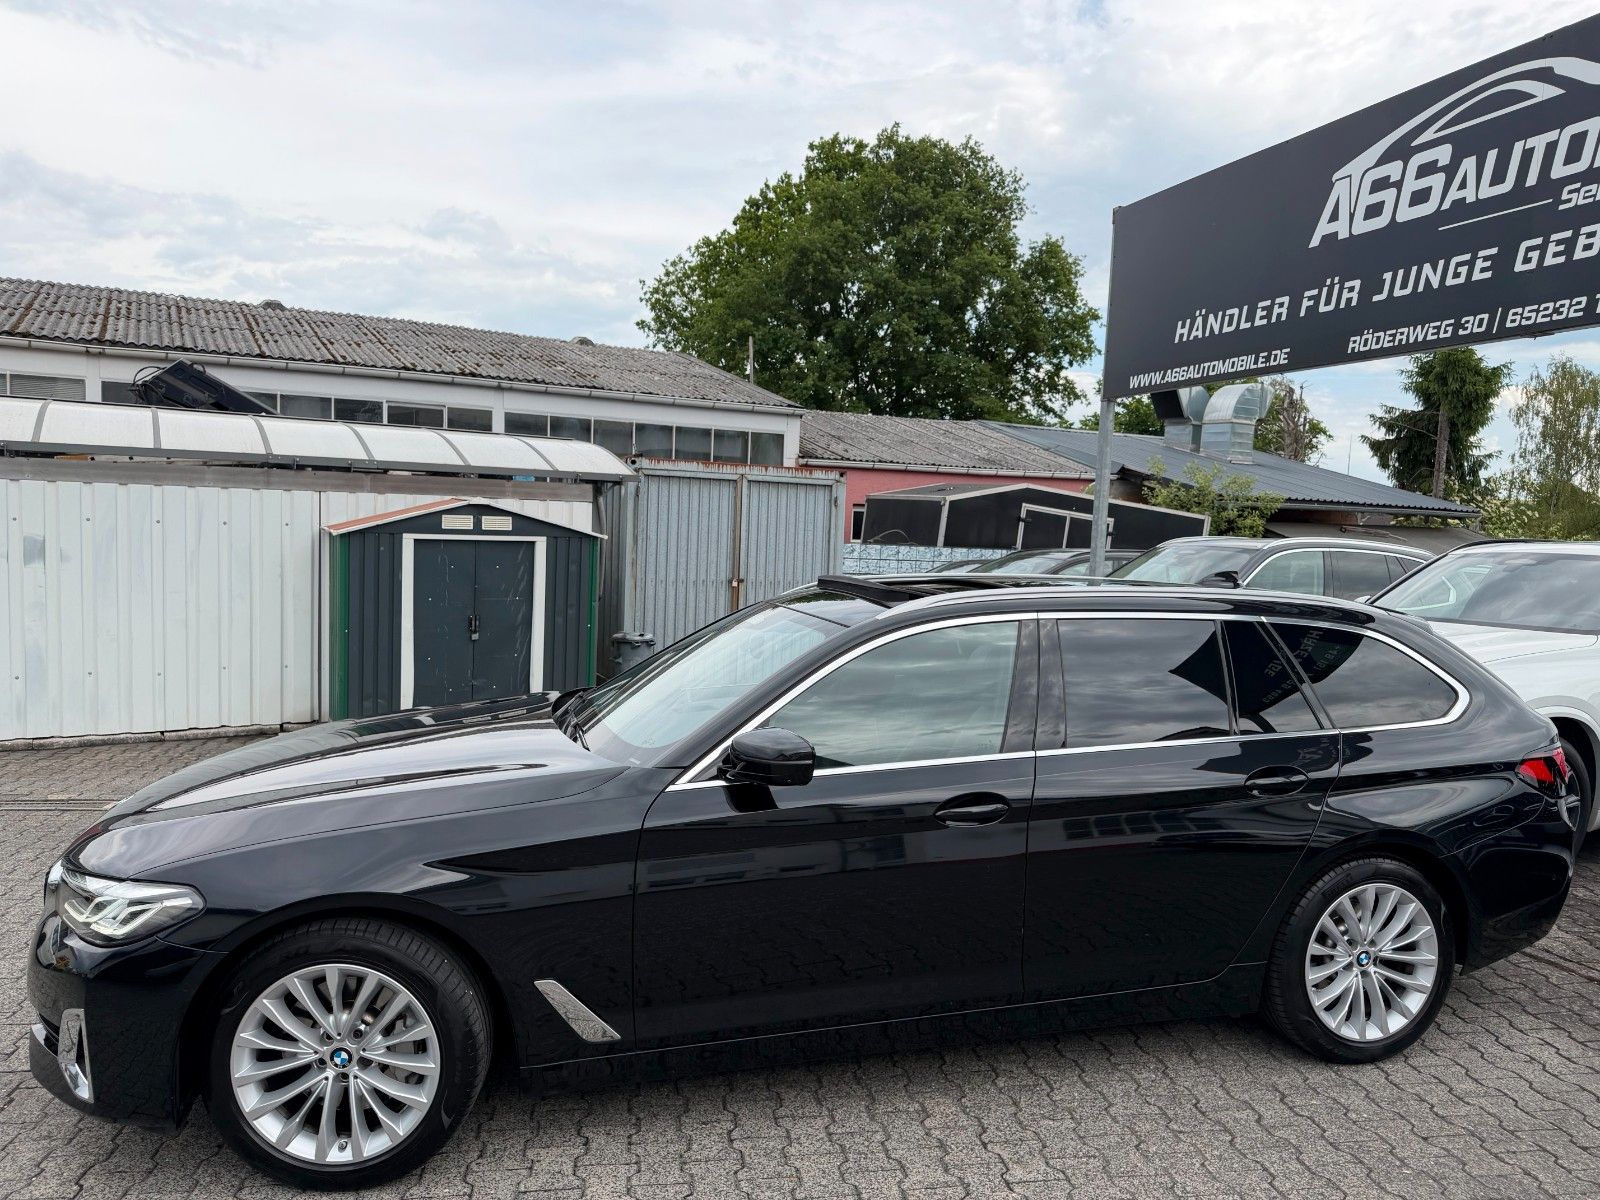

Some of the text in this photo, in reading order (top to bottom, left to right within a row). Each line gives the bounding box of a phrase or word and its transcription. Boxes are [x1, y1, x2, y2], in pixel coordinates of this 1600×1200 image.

[1308, 116, 1600, 248] A66AUTO
[1174, 295, 1290, 344] HÄNDLER
[1299, 276, 1361, 317] FÜR
[1372, 247, 1498, 302] JUNGE
[1347, 318, 1454, 354] RÖDERWEG
[1458, 313, 1489, 336] 30
[1505, 296, 1588, 328] 65232
[1129, 348, 1290, 389] WWW.A66AUTOMOBILE.DE
